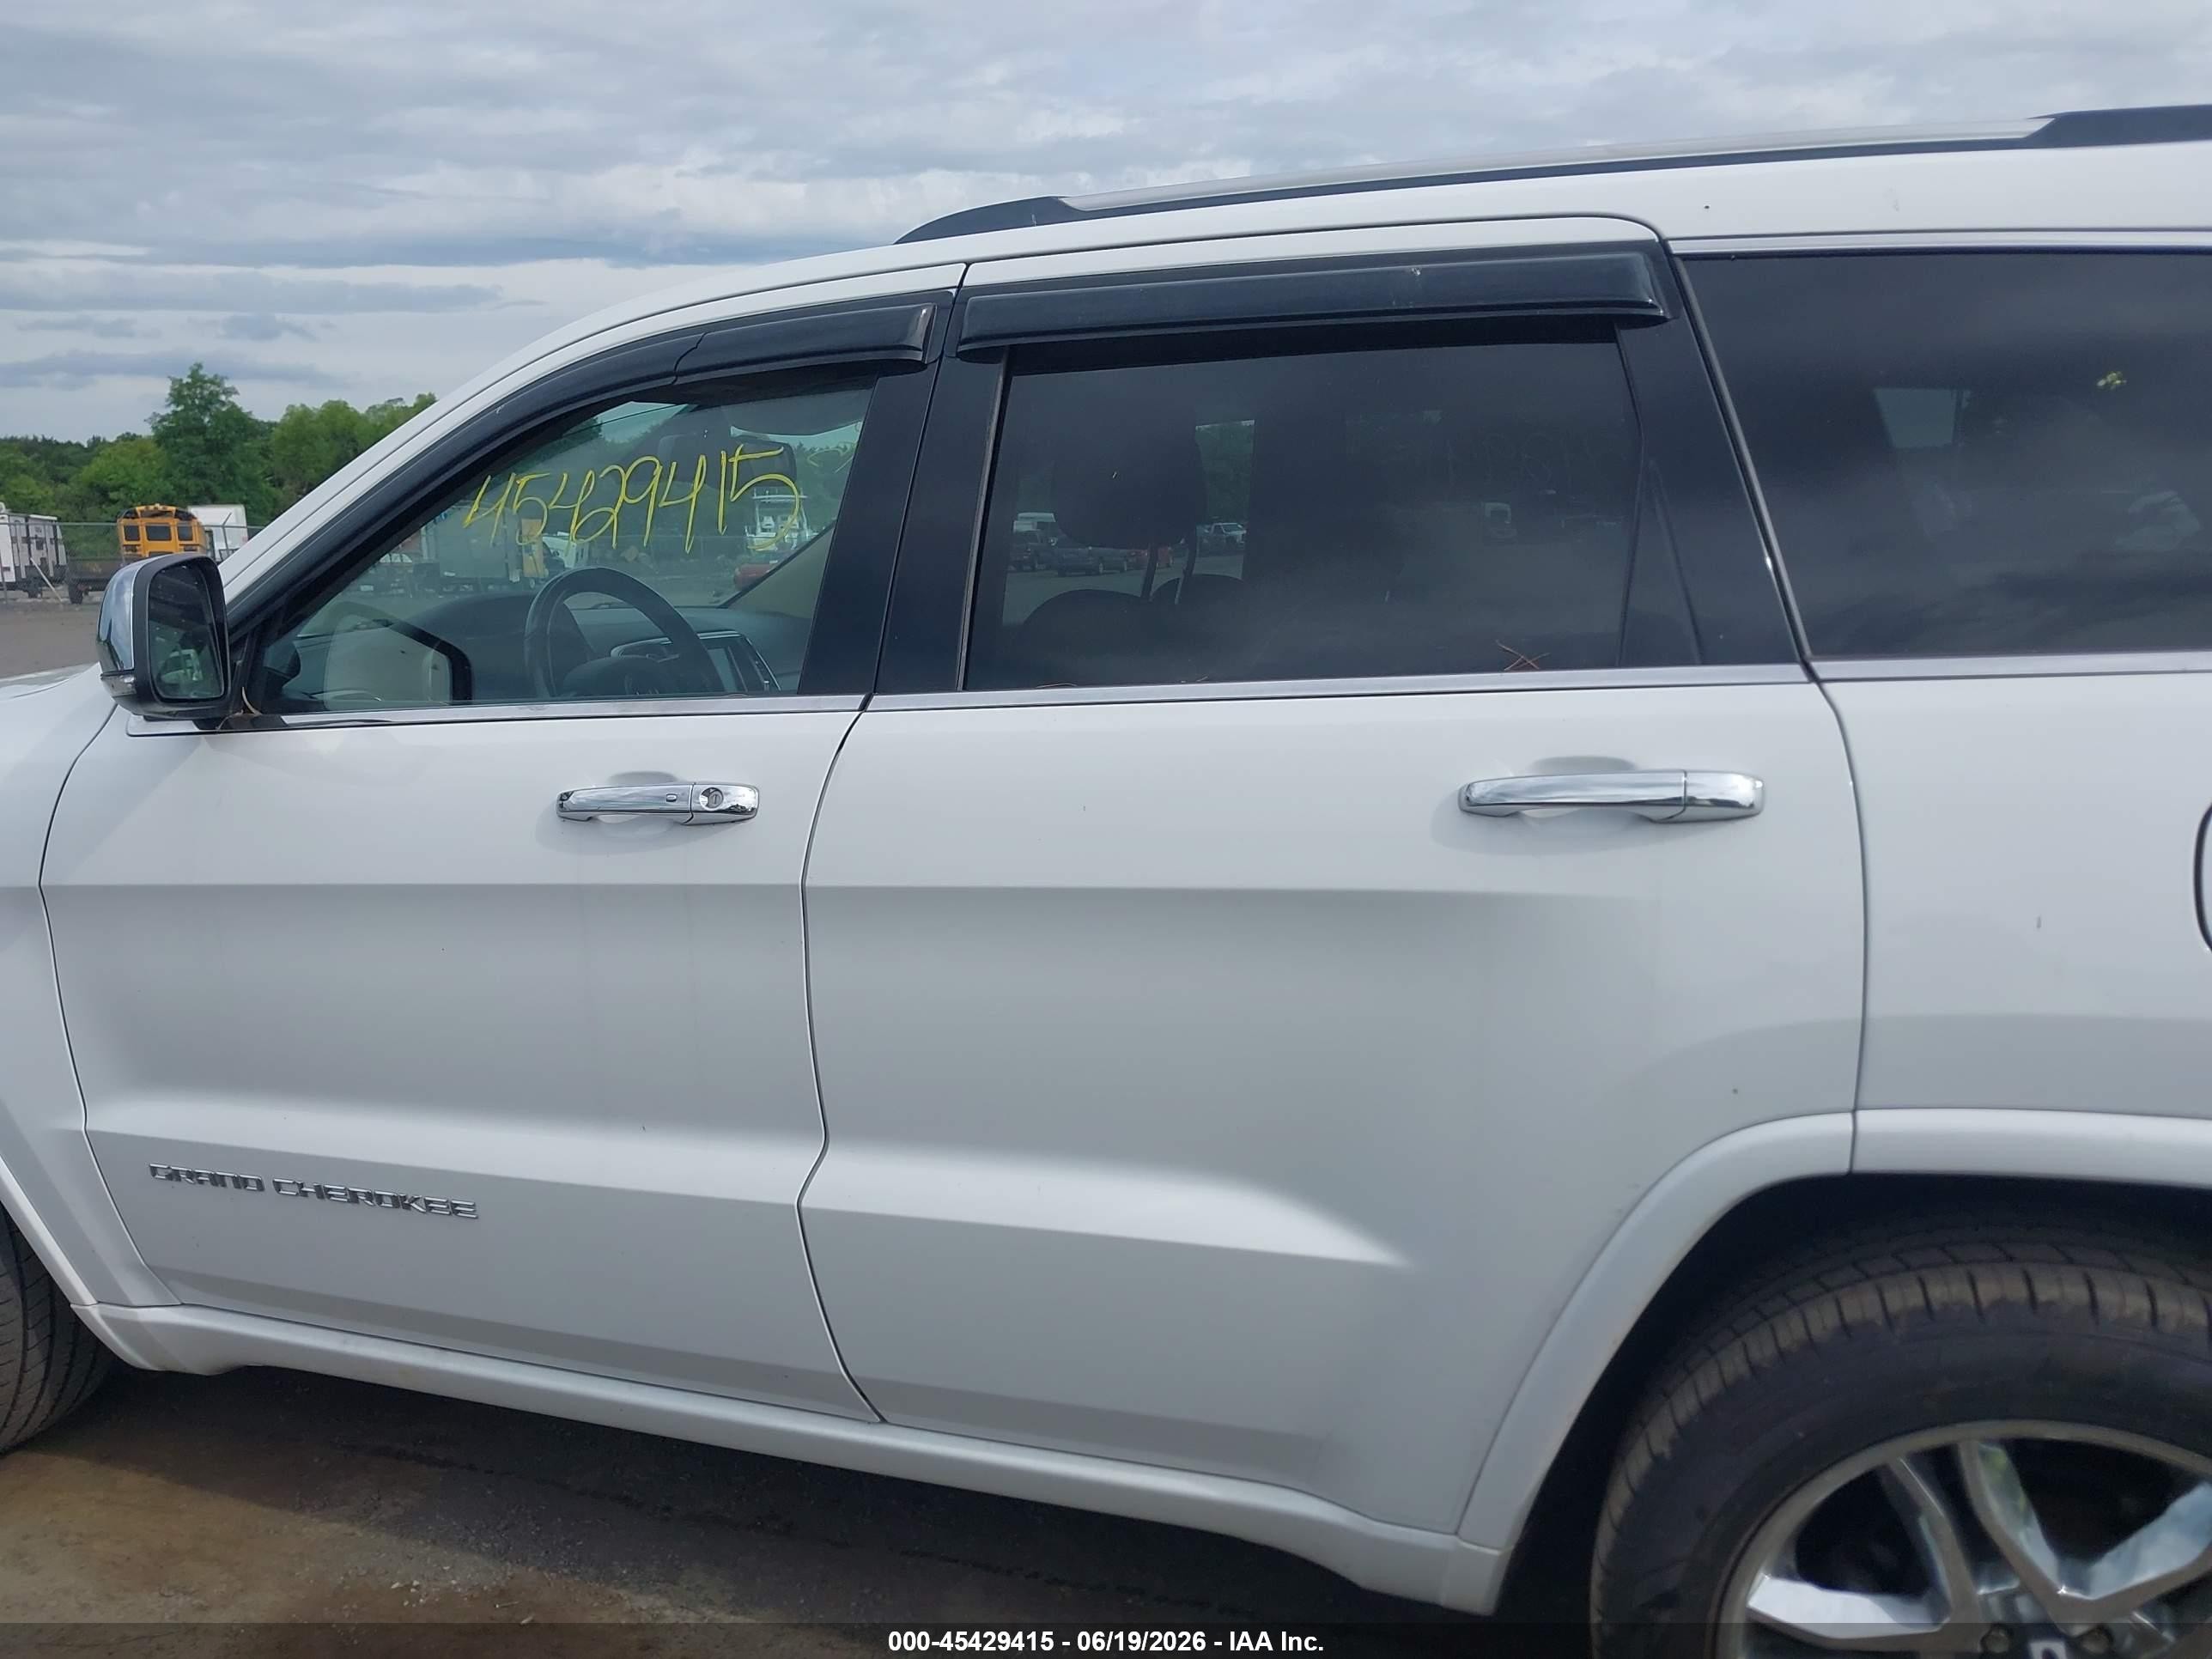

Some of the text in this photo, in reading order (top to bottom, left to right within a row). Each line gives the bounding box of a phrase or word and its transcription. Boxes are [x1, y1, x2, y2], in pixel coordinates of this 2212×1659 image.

[463, 444, 800, 554] 45429415
[149, 1163, 478, 1219] GRAND CHEROKEE
